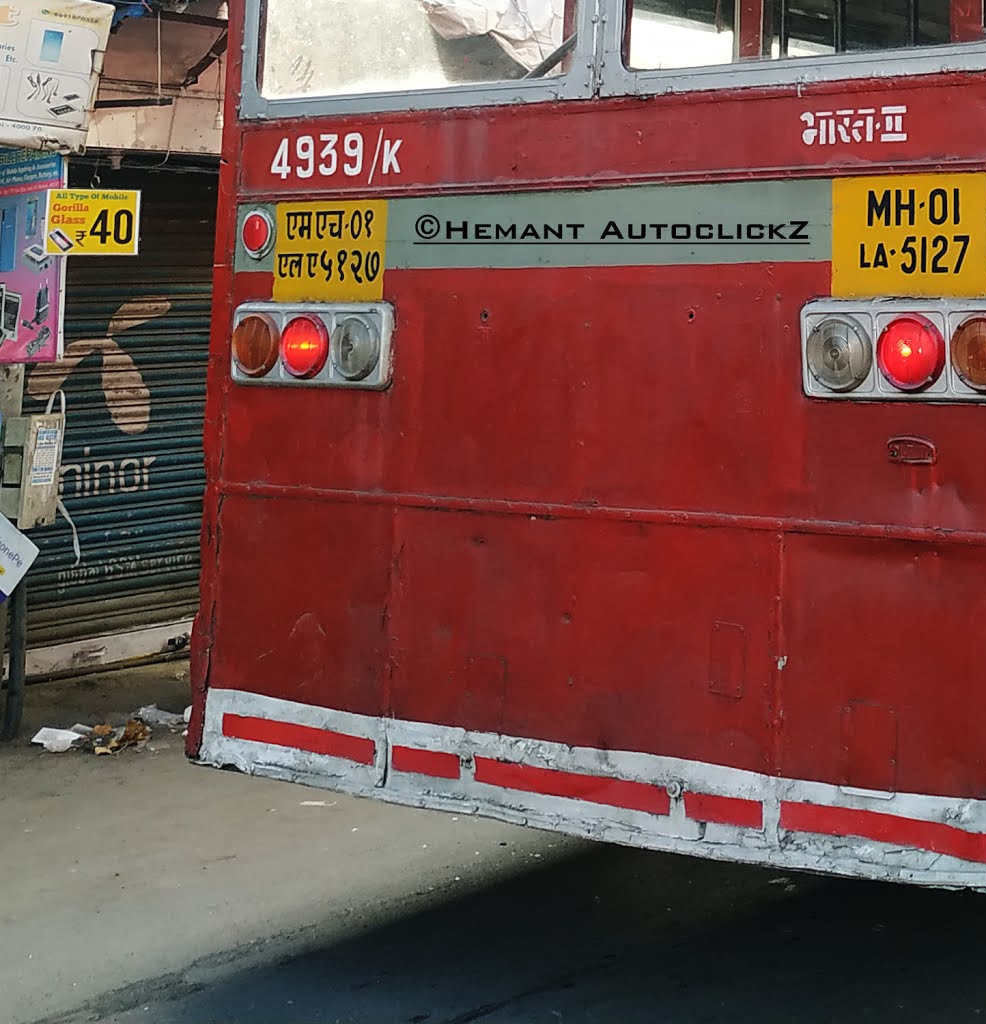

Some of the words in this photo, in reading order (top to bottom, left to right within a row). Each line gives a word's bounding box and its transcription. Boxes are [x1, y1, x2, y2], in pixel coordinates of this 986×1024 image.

[56, 192, 68, 200] All
[70, 192, 89, 201] Type
[101, 193, 128, 201] Mobile
[53, 202, 89, 212] Gorilla
[51, 214, 86, 225] Glass
[59, 447, 157, 498] ninor
[0, 541, 23, 568] onePe
